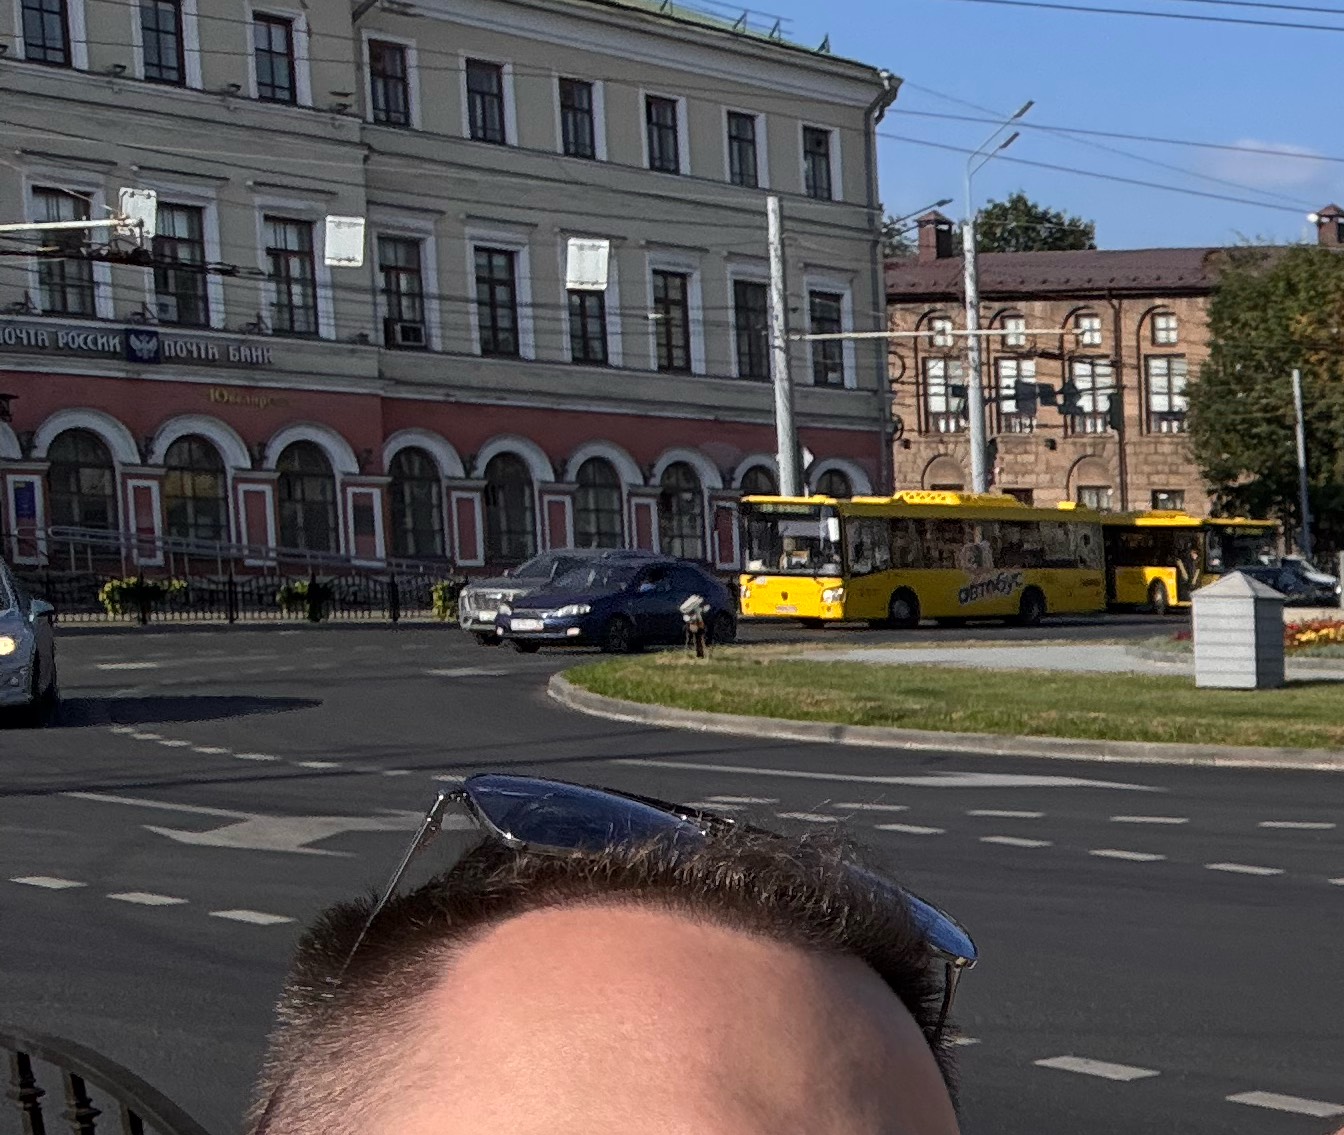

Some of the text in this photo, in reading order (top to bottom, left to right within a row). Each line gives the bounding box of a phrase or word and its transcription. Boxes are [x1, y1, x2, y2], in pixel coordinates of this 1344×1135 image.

[57, 330, 121, 352] РОССИИ
[163, 339, 273, 365] ПОЧТА БАНК
